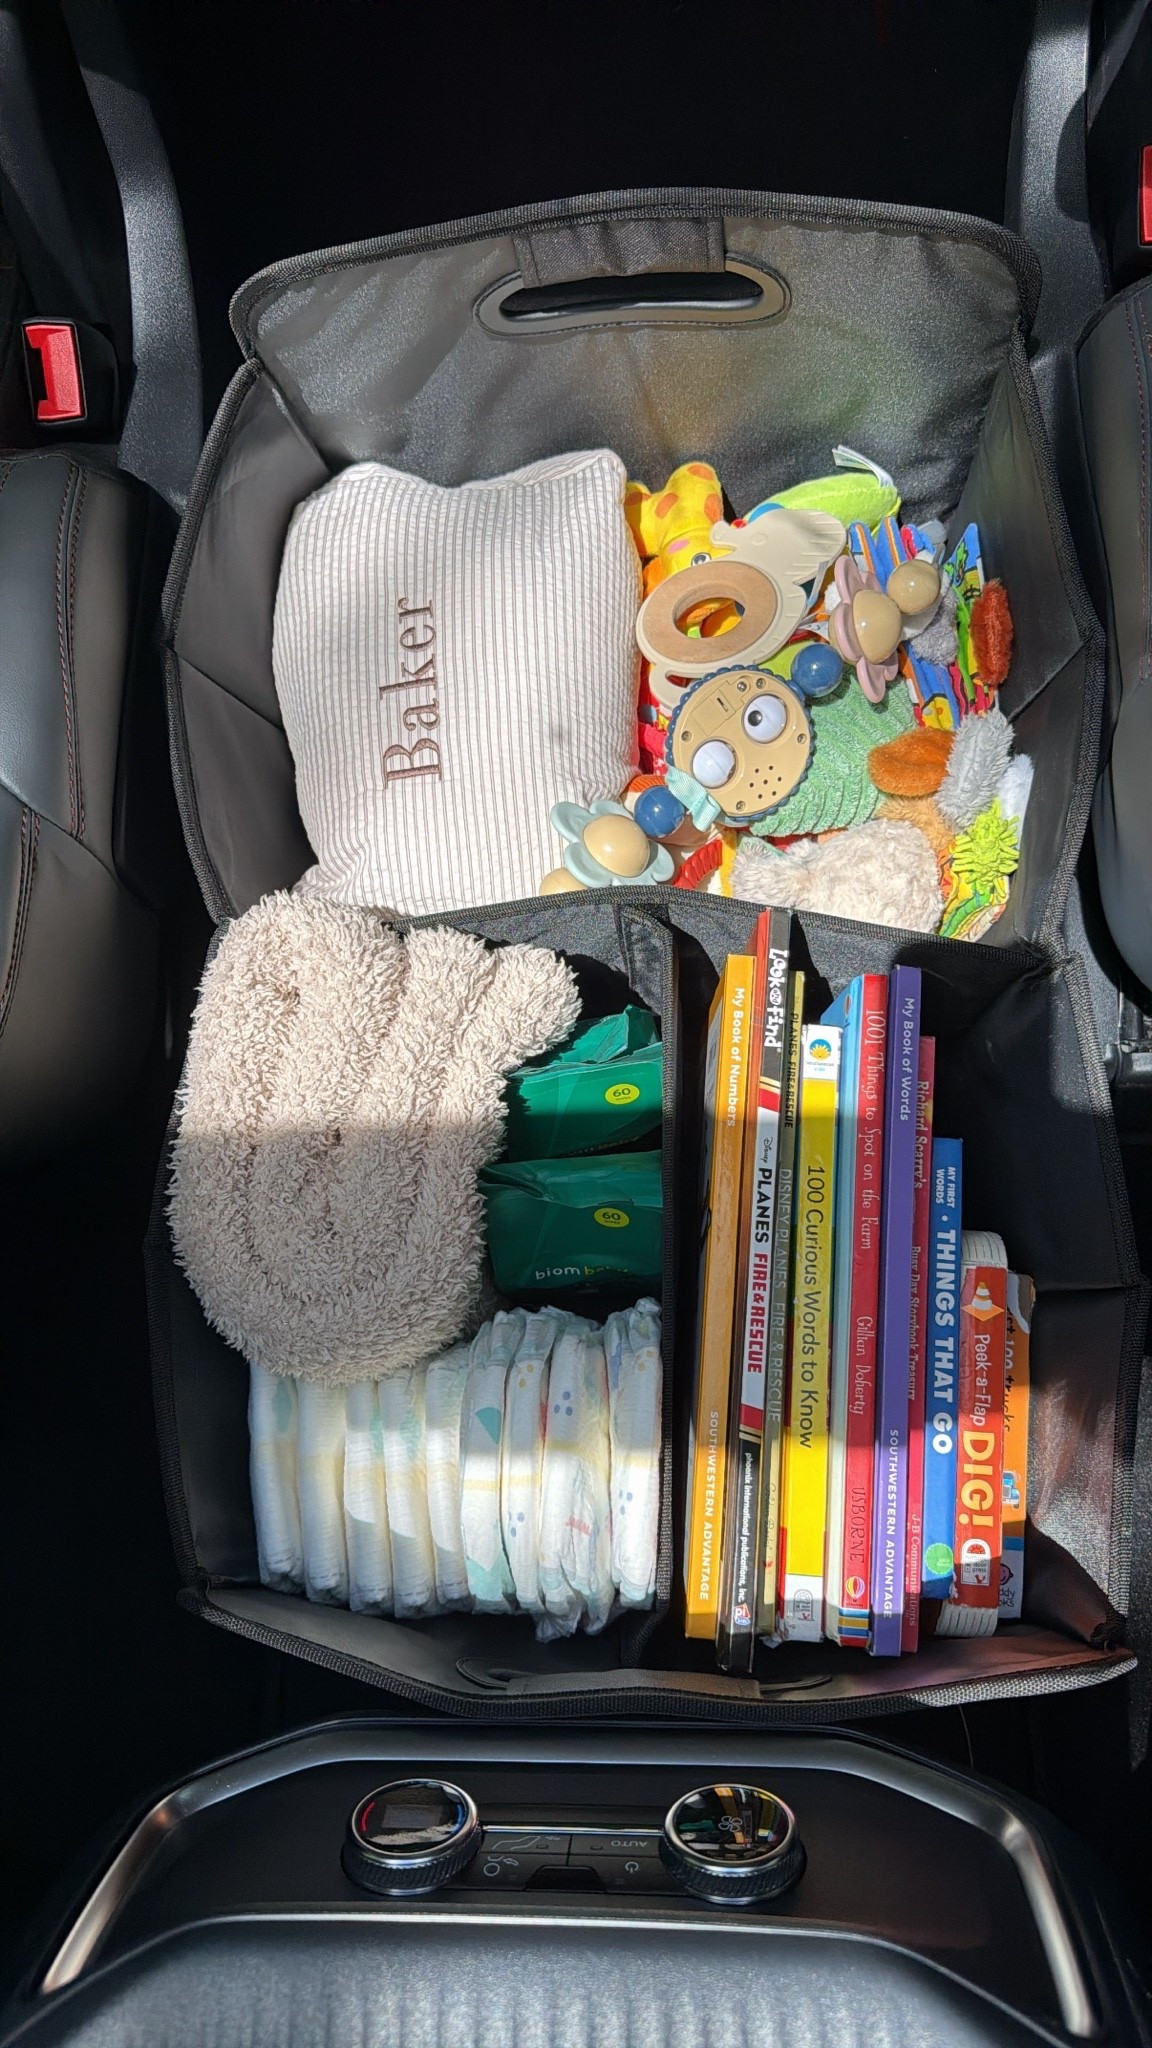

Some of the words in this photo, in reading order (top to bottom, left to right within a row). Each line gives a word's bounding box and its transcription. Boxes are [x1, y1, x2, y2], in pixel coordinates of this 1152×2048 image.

[379, 597, 442, 789] Baker
[768, 948, 788, 988] Look
[732, 987, 745, 1007] My
[903, 997, 915, 1018] My
[731, 1011, 745, 1043] Book
[765, 1007, 784, 1048] Find
[788, 1012, 800, 1056] PLANES
[864, 1010, 886, 1045] 1001
[902, 1021, 914, 1055] Book
[730, 1046, 742, 1061] of
[902, 1058, 912, 1074] of
[613, 1088, 630, 1097] 60
[727, 1064, 741, 1127] Numbers
[784, 1062, 797, 1128] FIRE&RESCUE
[861, 1052, 884, 1100] Things
[865, 1107, 879, 1120] to
[900, 1076, 912, 1121] Words
[915, 1081, 929, 1131] Richard
[760, 1137, 773, 1164] Disney
[859, 1127, 881, 1156] Spot
[913, 1135, 927, 1188] Scarry's
[806, 1165, 825, 1203] 100
[863, 1164, 874, 1180] on
[936, 1168, 946, 1204] WORDS
[947, 1166, 956, 1182] MY
[602, 1212, 620, 1220] 60
[755, 1168, 773, 1244] PLANES
[777, 1168, 792, 1224] DISNEY
[862, 1190, 880, 1209] the
[946, 1183, 956, 1208] FIRST
[804, 1209, 825, 1285] Curious
[861, 1216, 879, 1249] Farm
[535, 1267, 580, 1280] biom
[774, 1229, 789, 1289] PLANES
[934, 1230, 956, 1327] THINGS
[747, 1252, 769, 1374] FIRE&RESCUE
[771, 1302, 785, 1336] FIRE
[802, 1291, 821, 1355] Words
[770, 1343, 782, 1352] &
[856, 1316, 874, 1356] Gillian
[767, 1358, 783, 1422] RESCUE
[801, 1361, 817, 1383] to
[850, 1364, 872, 1415] Doherty
[933, 1337, 954, 1402] THAT
[970, 1334, 992, 1427] Peek-a-Flap
[799, 1390, 818, 1448] Know
[932, 1411, 953, 1454] GO
[704, 1411, 719, 1517] SOUTHWESTERN
[743, 1452, 753, 1484] phoenix
[886, 1429, 899, 1535] SOUTHWESTERN
[958, 1430, 995, 1528] DIG!
[741, 1485, 752, 1535] international
[850, 1486, 866, 1563] USBORNE
[911, 1513, 920, 1534] J-B
[699, 1522, 713, 1601] ADVANTAGE
[738, 1537, 750, 1586] publications,
[883, 1540, 896, 1618] ADVANTAGE
[738, 1588, 748, 1602] inc.
